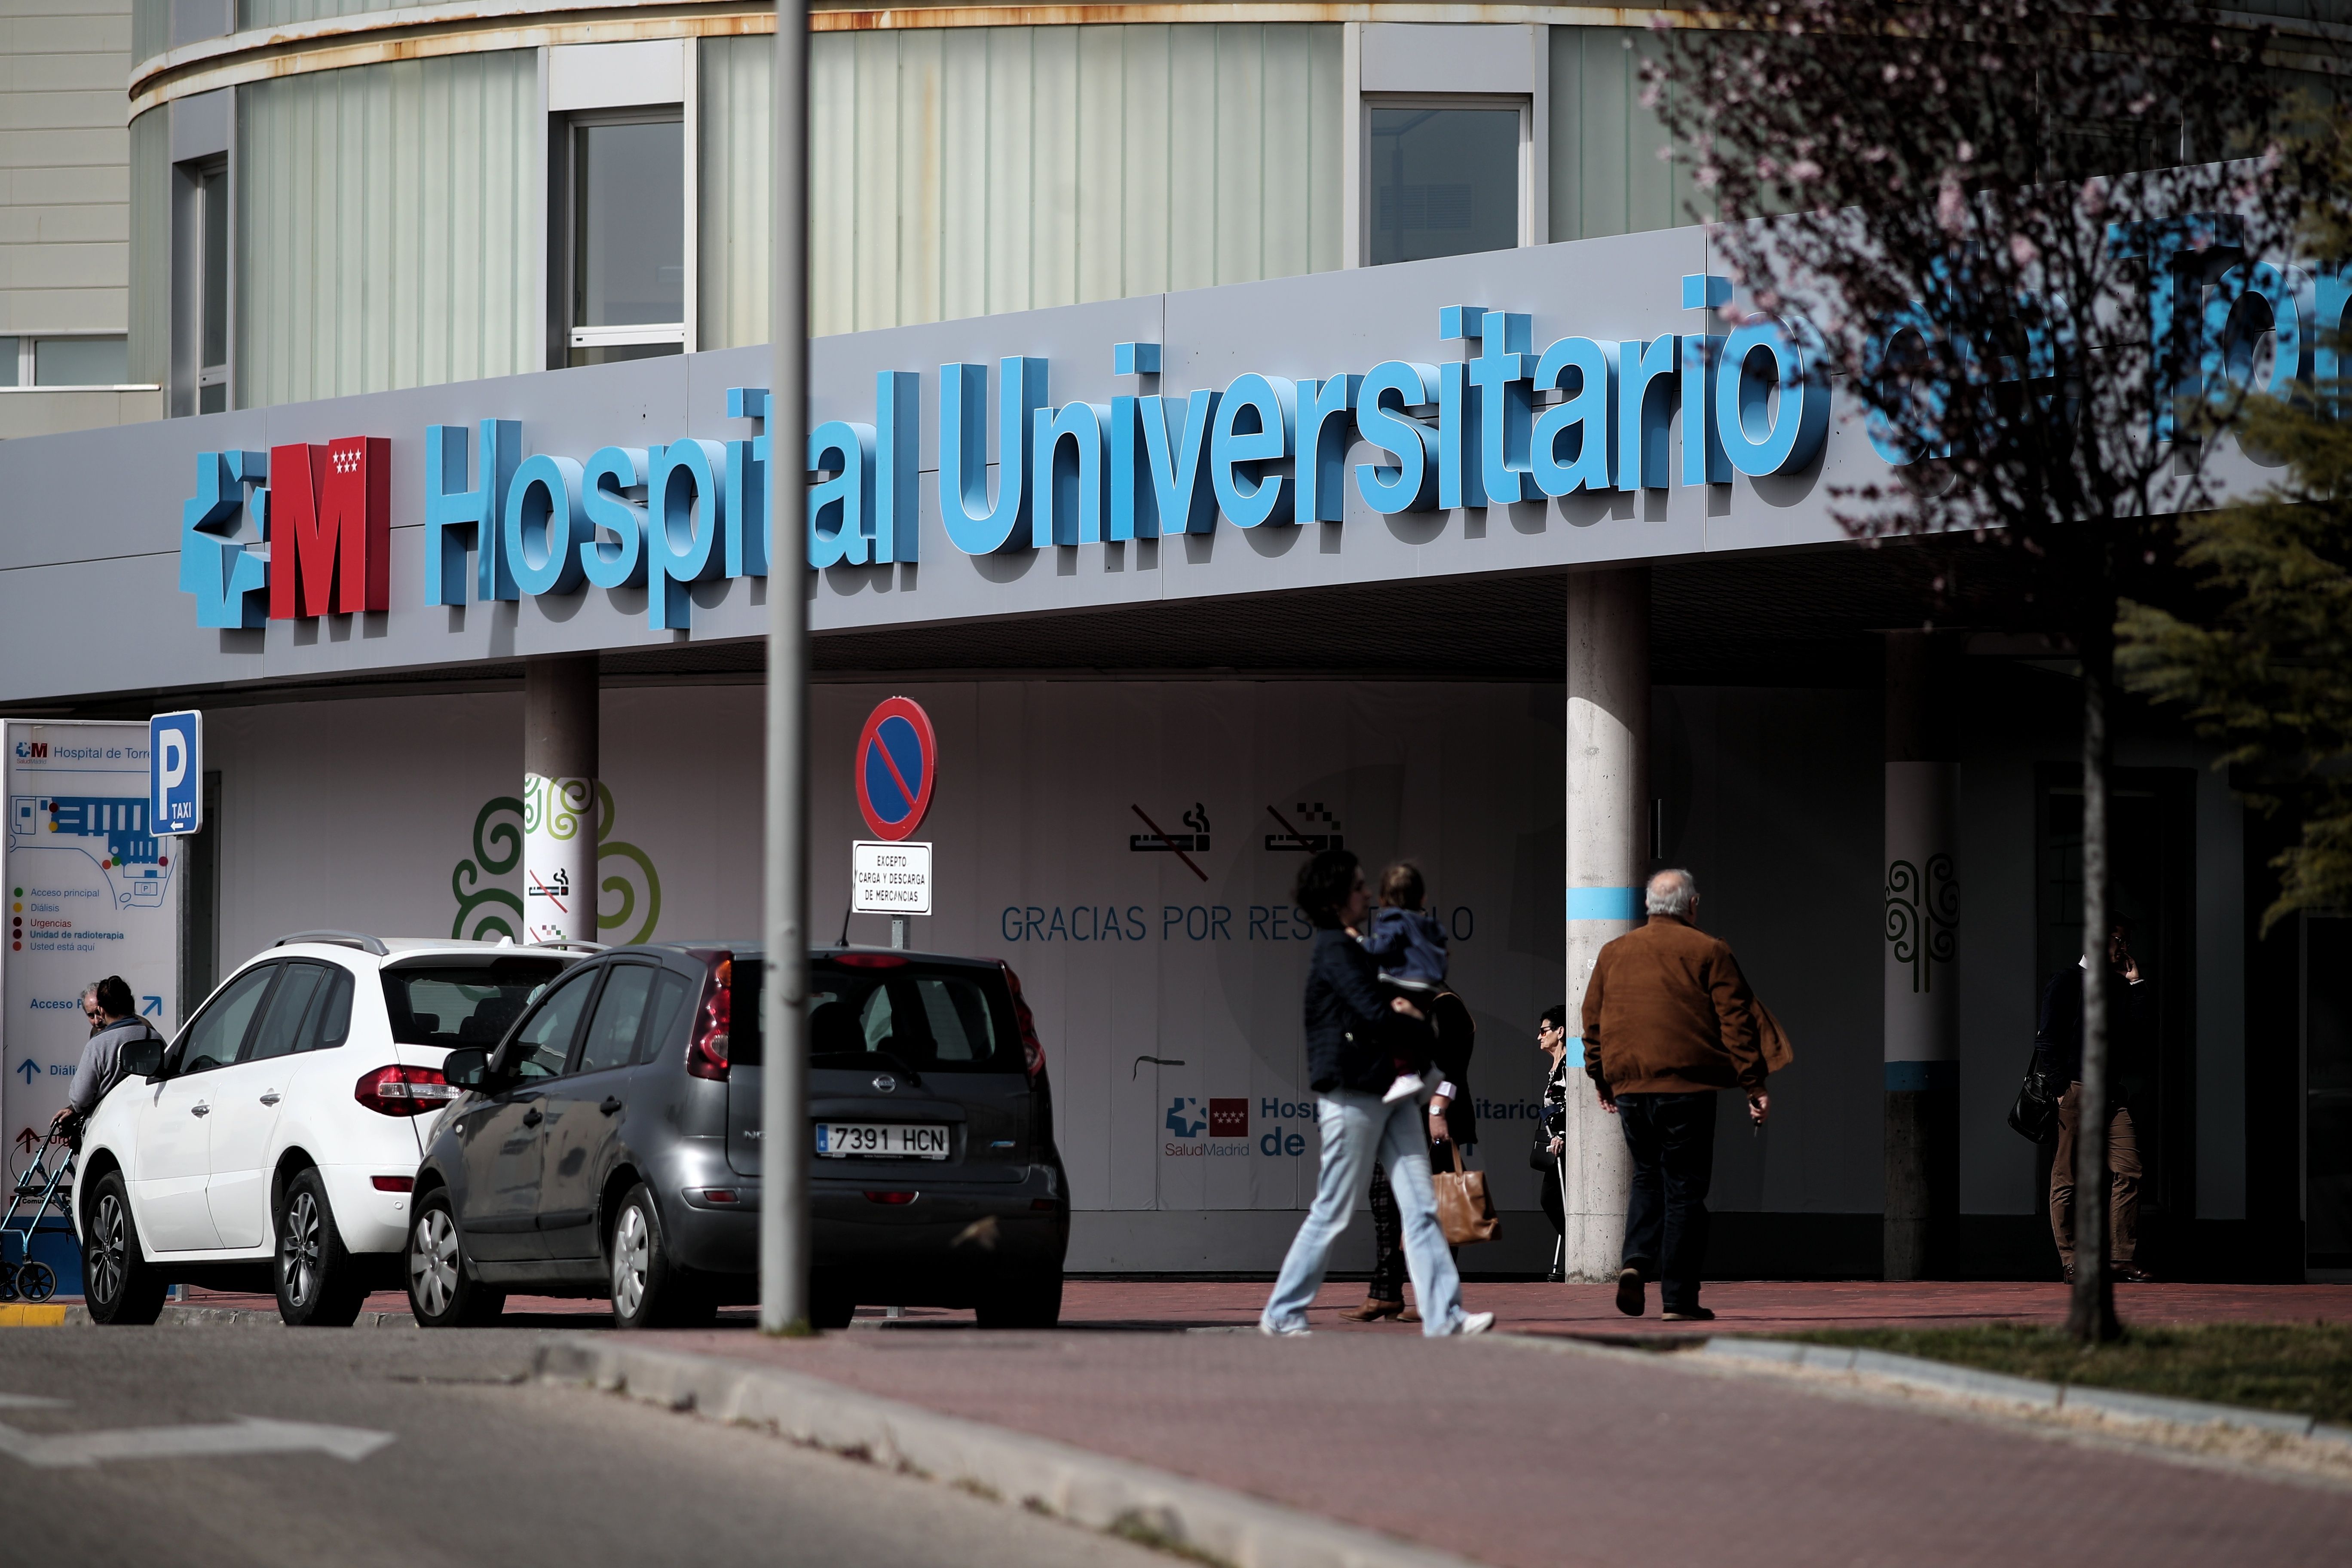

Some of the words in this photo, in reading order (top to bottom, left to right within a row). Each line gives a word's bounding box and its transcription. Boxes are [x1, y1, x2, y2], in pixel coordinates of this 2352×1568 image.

[939, 274, 1816, 555] Universitario
[54, 747, 102, 760] Hospital
[106, 747, 121, 759] de
[125, 747, 150, 759] Torr
[159, 729, 187, 821] P
[172, 802, 191, 819] TAXI
[877, 855, 906, 867] EXCEPTO
[859, 872, 880, 883] CARGA
[883, 873, 887, 883] Y
[889, 873, 925, 885] DESCARGA
[31, 888, 61, 897] Acceso
[64, 889, 99, 898] principal
[865, 889, 873, 900] DE
[876, 890, 918, 902] MERCANCIAS
[31, 903, 59, 912] Diálisis
[31, 919, 72, 928] Urgencias
[1002, 906, 1146, 941] GRACIAS
[1164, 906, 1231, 941] POR
[30, 930, 59, 938] Unidad
[74, 931, 124, 940] radioterapia
[31, 942, 54, 950] Usted
[57, 943, 74, 951] está
[77, 943, 95, 952] aquí
[30, 999, 73, 1009] Acceso
[836, 1127, 888, 1150] 7391
[903, 1129, 944, 1151] HCN
[1260, 1126, 1306, 1156] de
[1165, 1143, 1250, 1156] SaludMadrid
